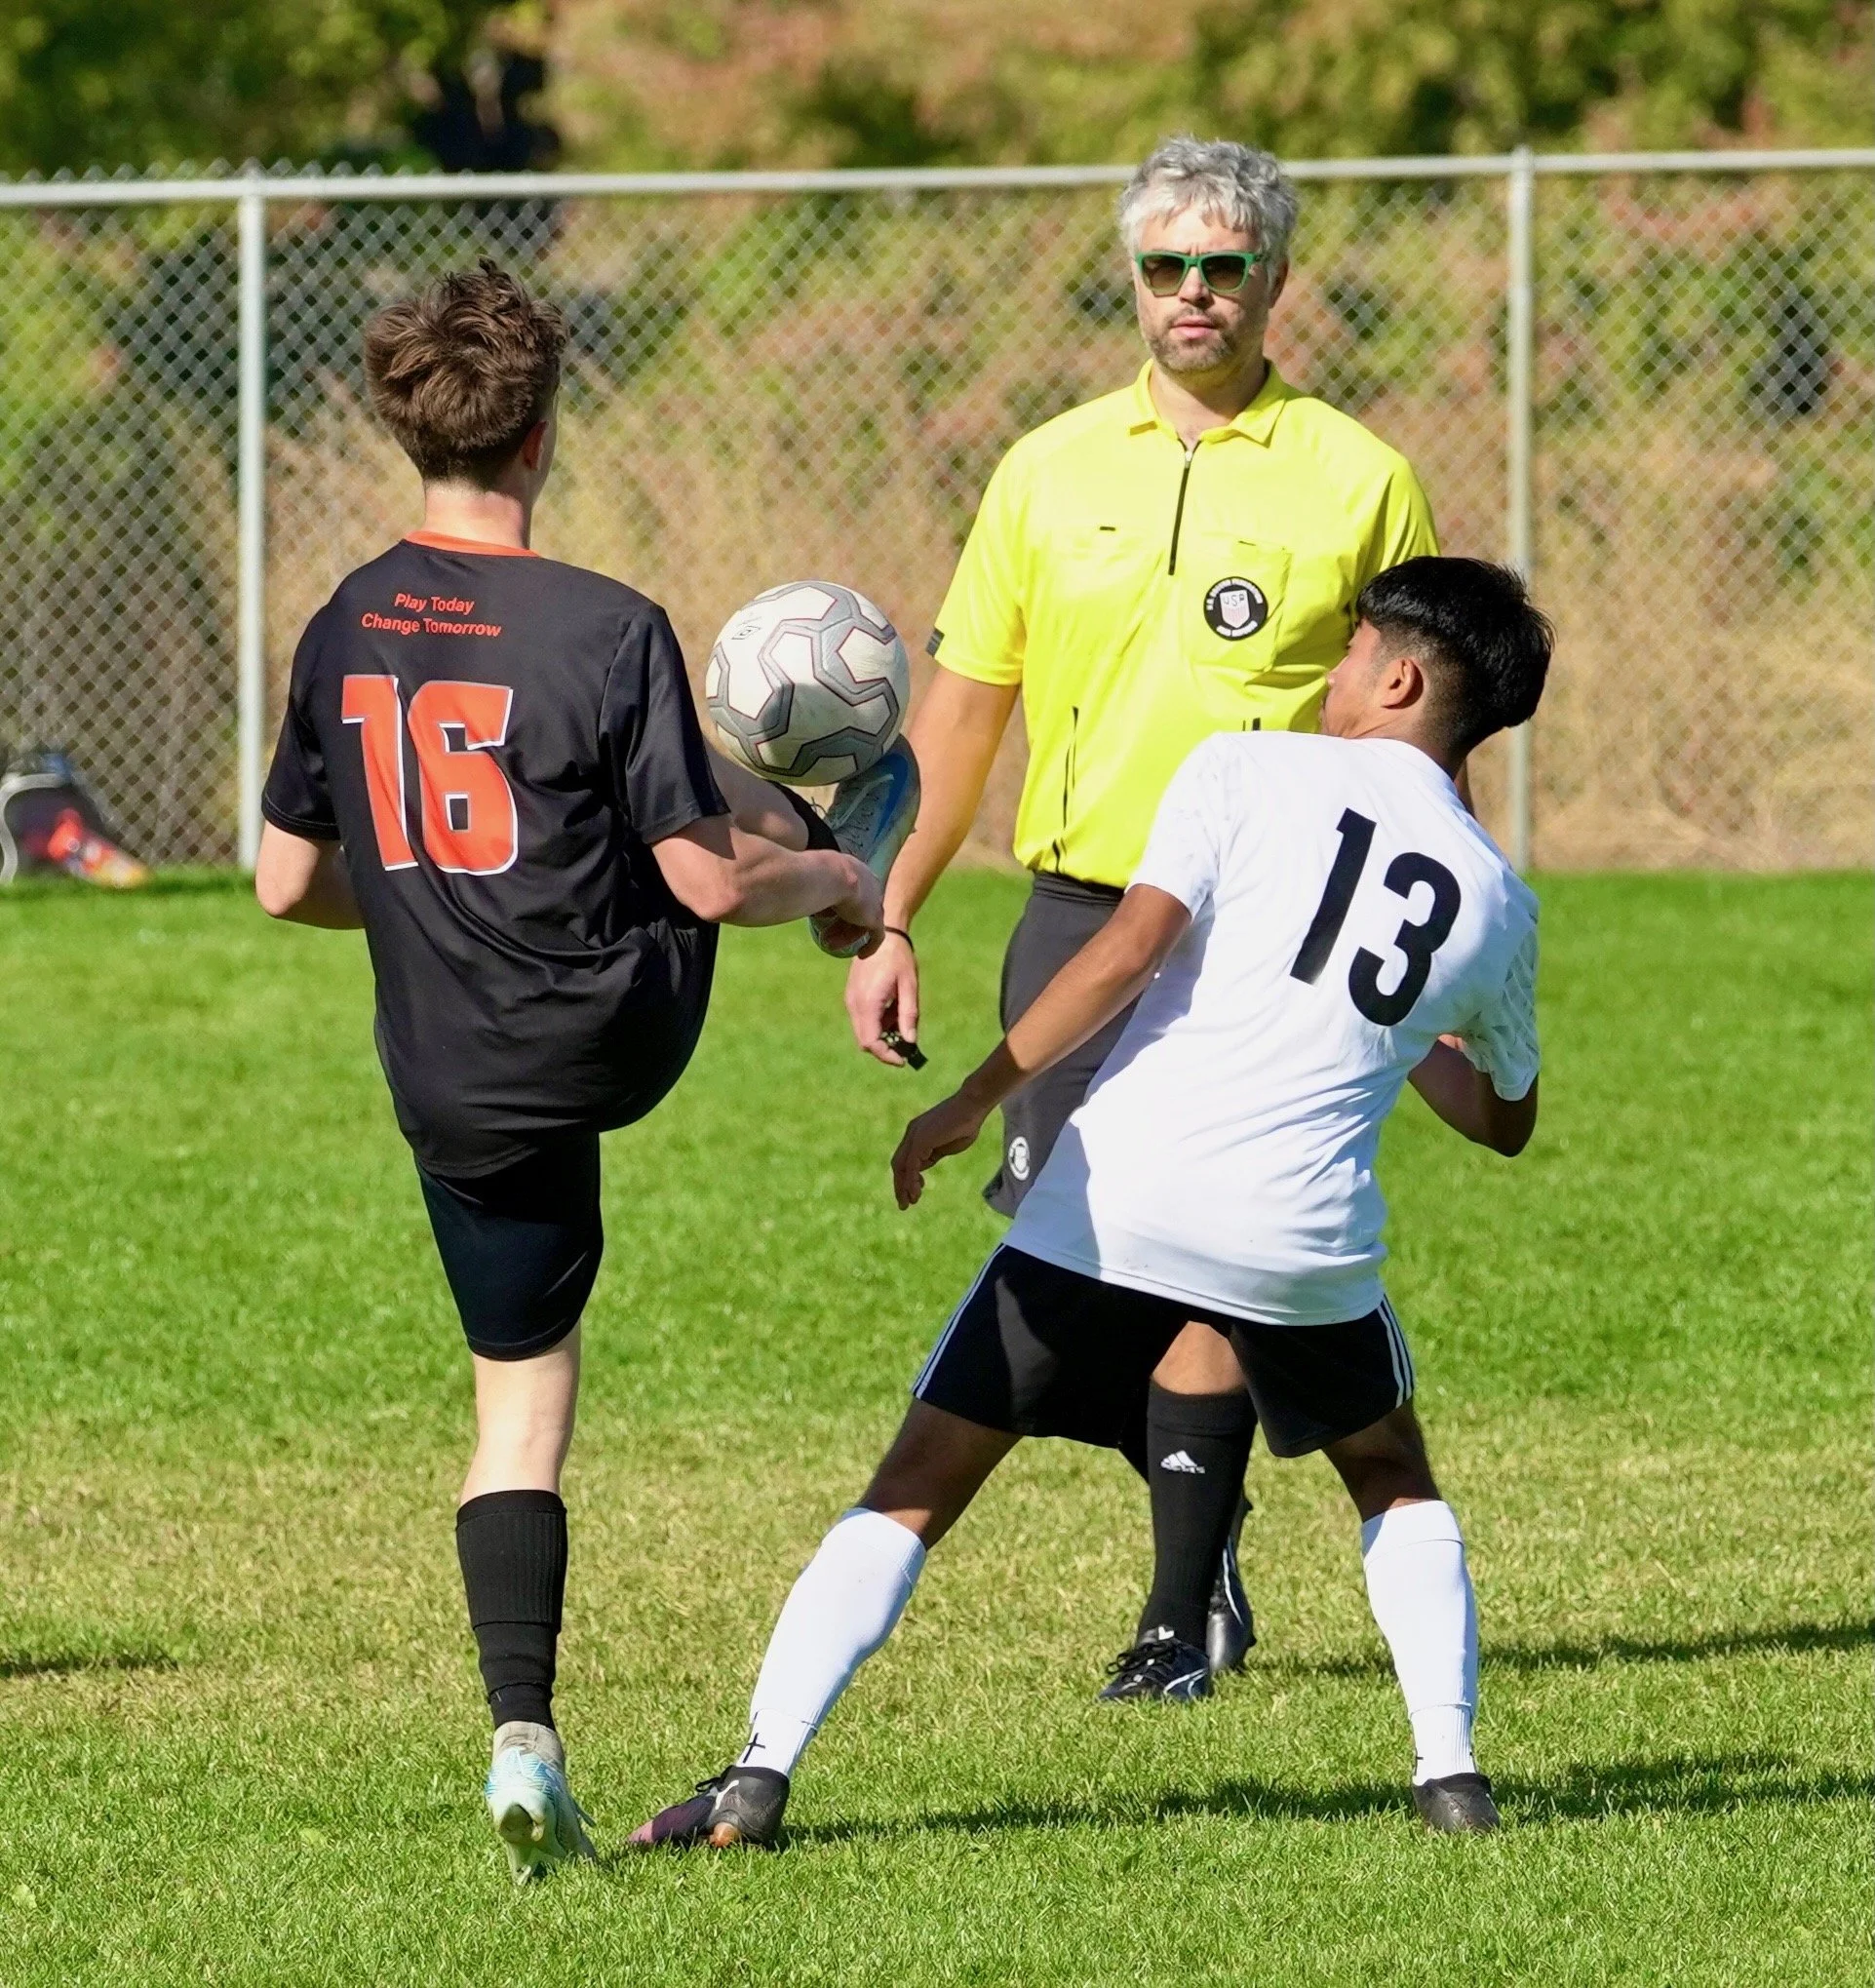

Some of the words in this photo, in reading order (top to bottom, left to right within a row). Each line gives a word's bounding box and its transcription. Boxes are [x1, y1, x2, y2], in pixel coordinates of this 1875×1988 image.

[361, 612, 420, 635] Change
[423, 618, 501, 637] Tomorrow
[394, 593, 427, 612] Play
[430, 596, 475, 615] Today
[341, 674, 519, 876] 16
[1290, 807, 1461, 1027] 13
